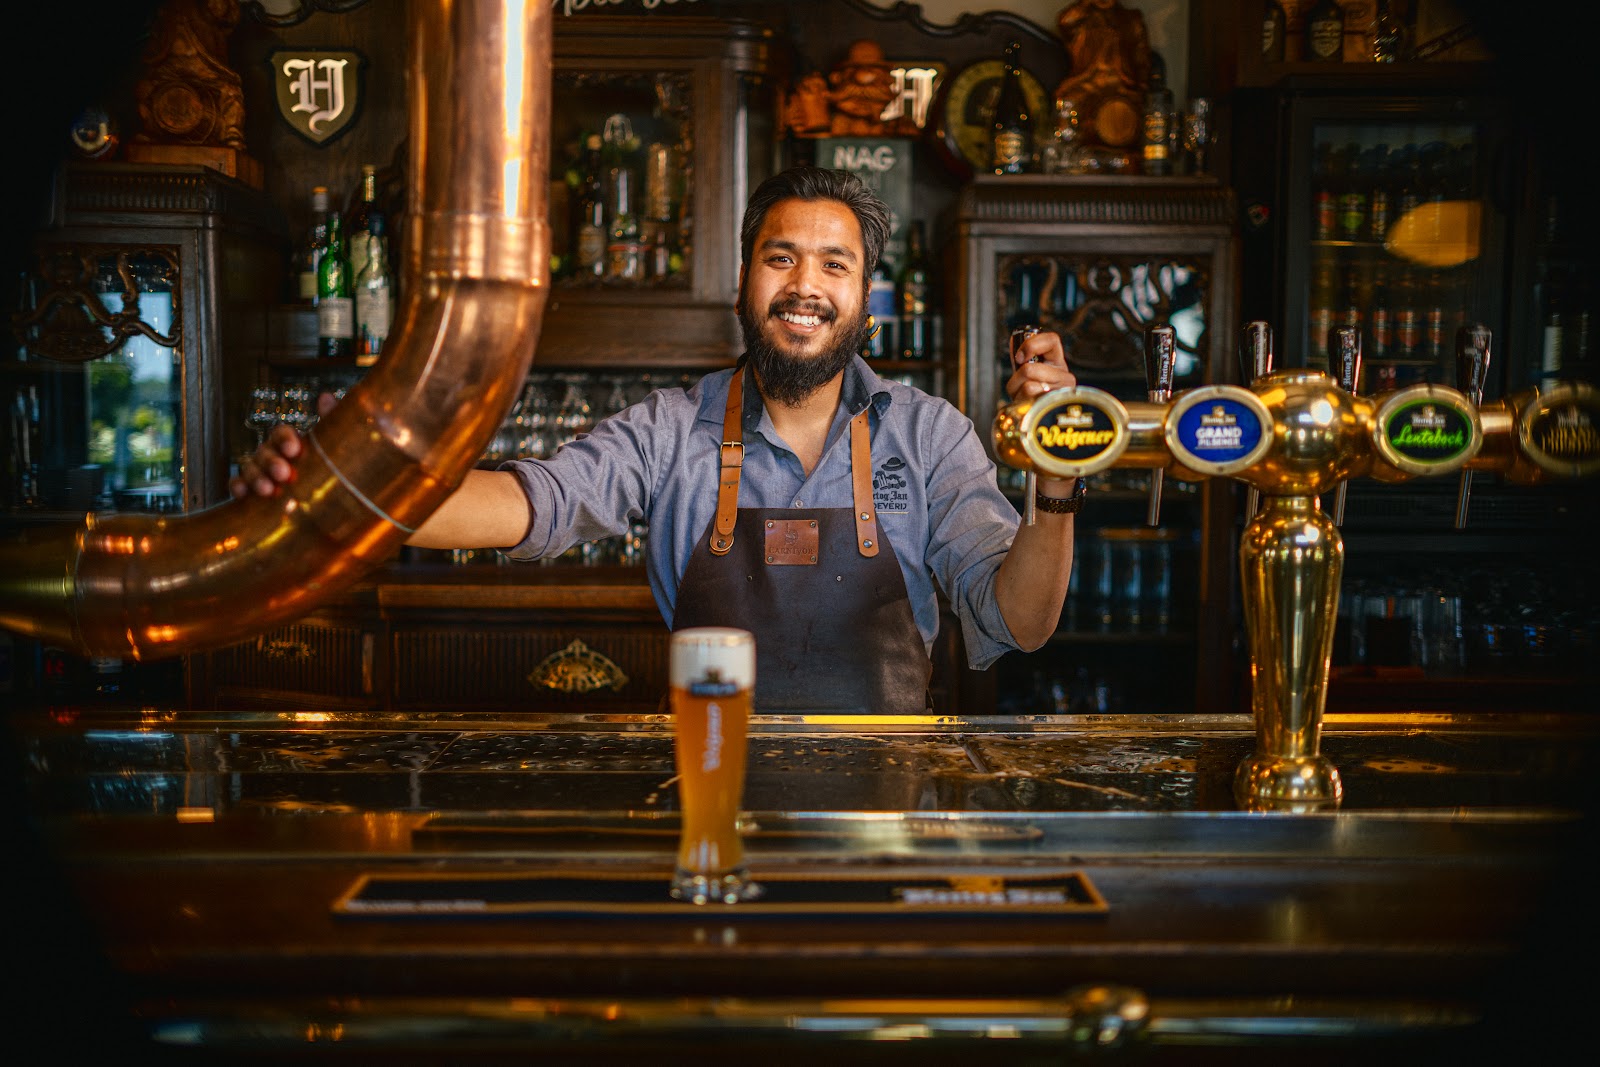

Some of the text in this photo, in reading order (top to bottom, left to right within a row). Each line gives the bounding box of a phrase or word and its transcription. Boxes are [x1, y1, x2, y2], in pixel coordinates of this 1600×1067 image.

[833, 145, 896, 171] NAG
[1037, 425, 1114, 450] Weizener
[1195, 426, 1243, 439] GRAND
[1198, 438, 1241, 447] PILSENER
[1391, 423, 1464, 448] Lentebock
